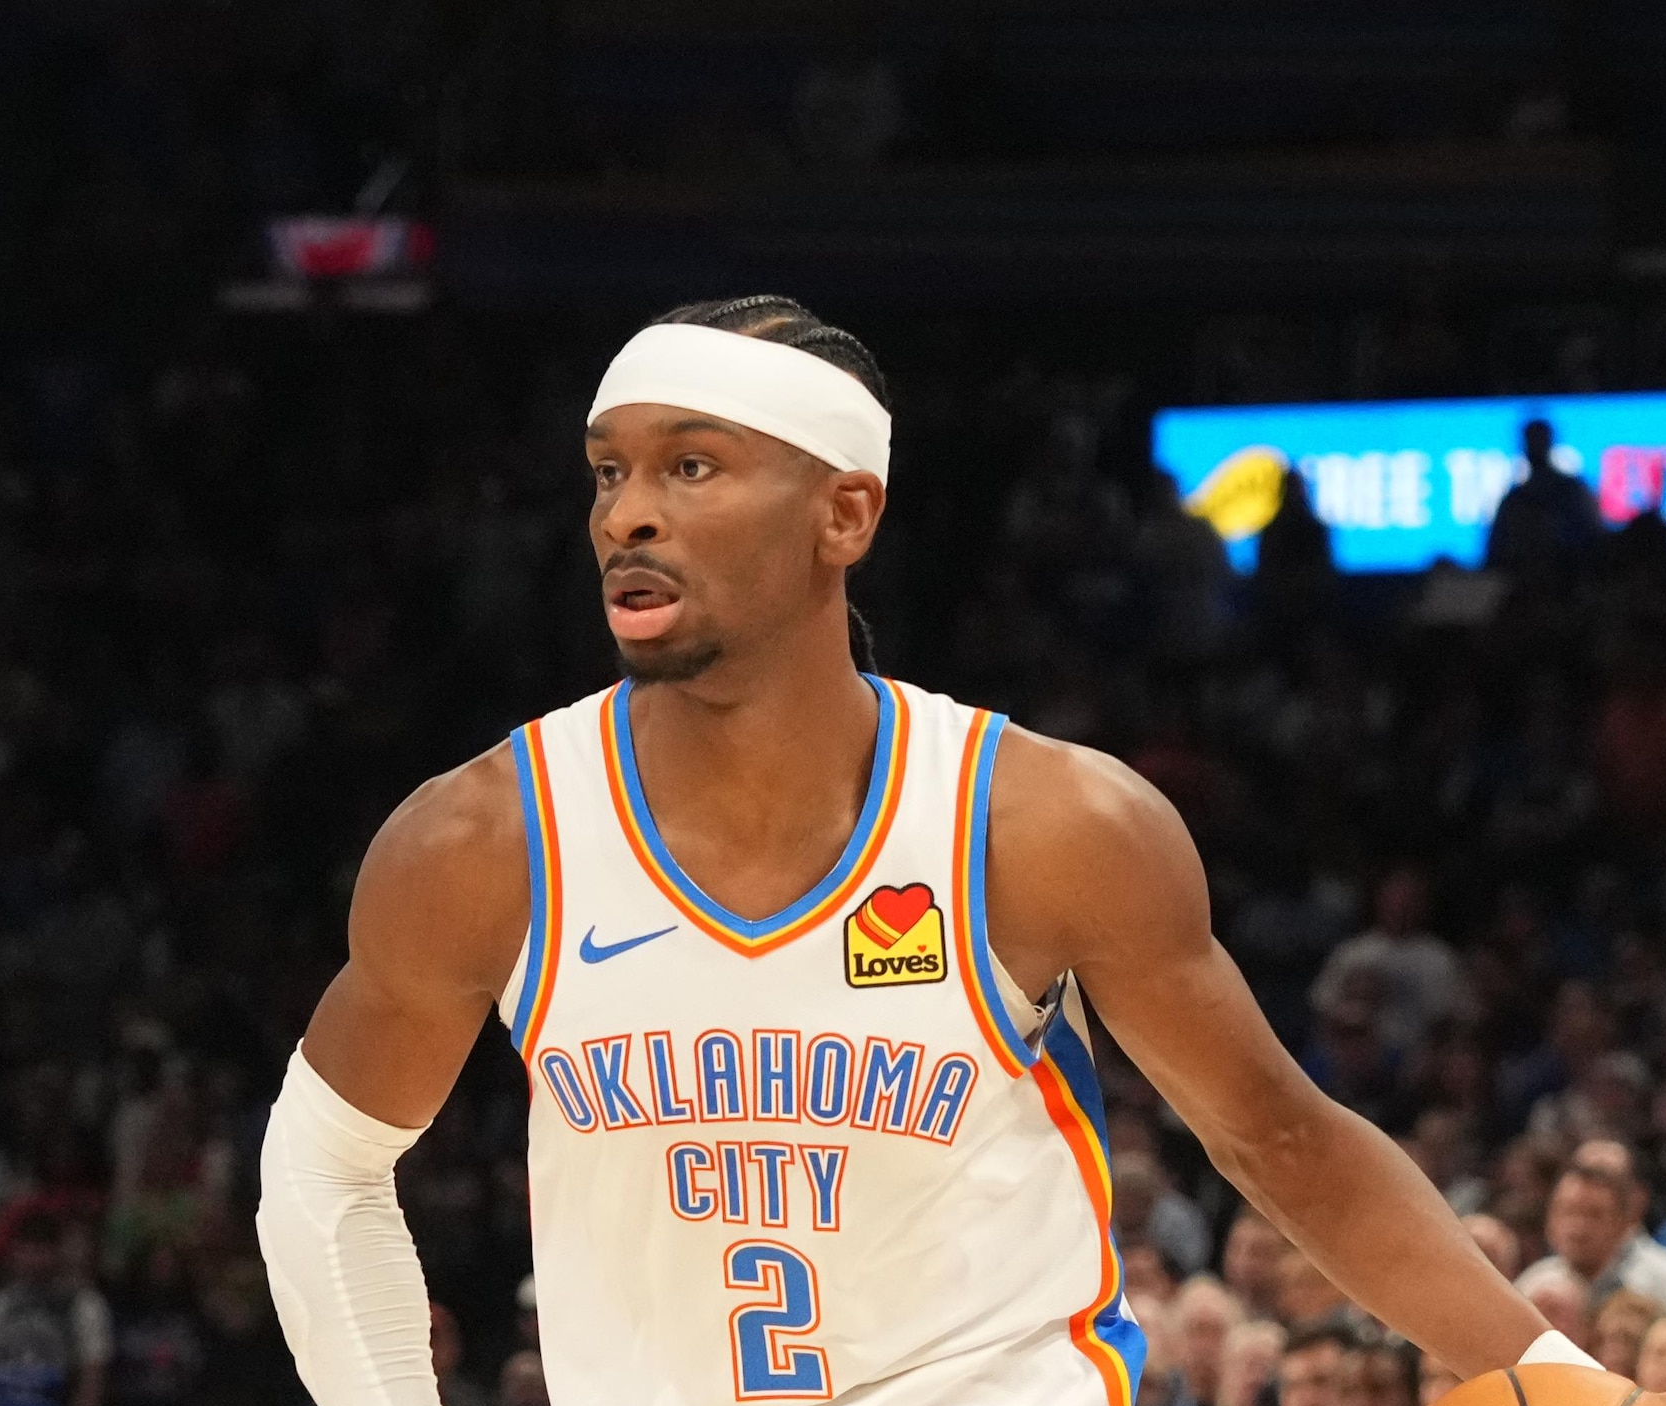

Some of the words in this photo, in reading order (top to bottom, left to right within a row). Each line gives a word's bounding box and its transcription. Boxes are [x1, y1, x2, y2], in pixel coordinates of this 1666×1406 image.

[538, 1028, 979, 1146] OKLAHOMA
[665, 1141, 849, 1232] CITY
[723, 1239, 833, 1402] 2
